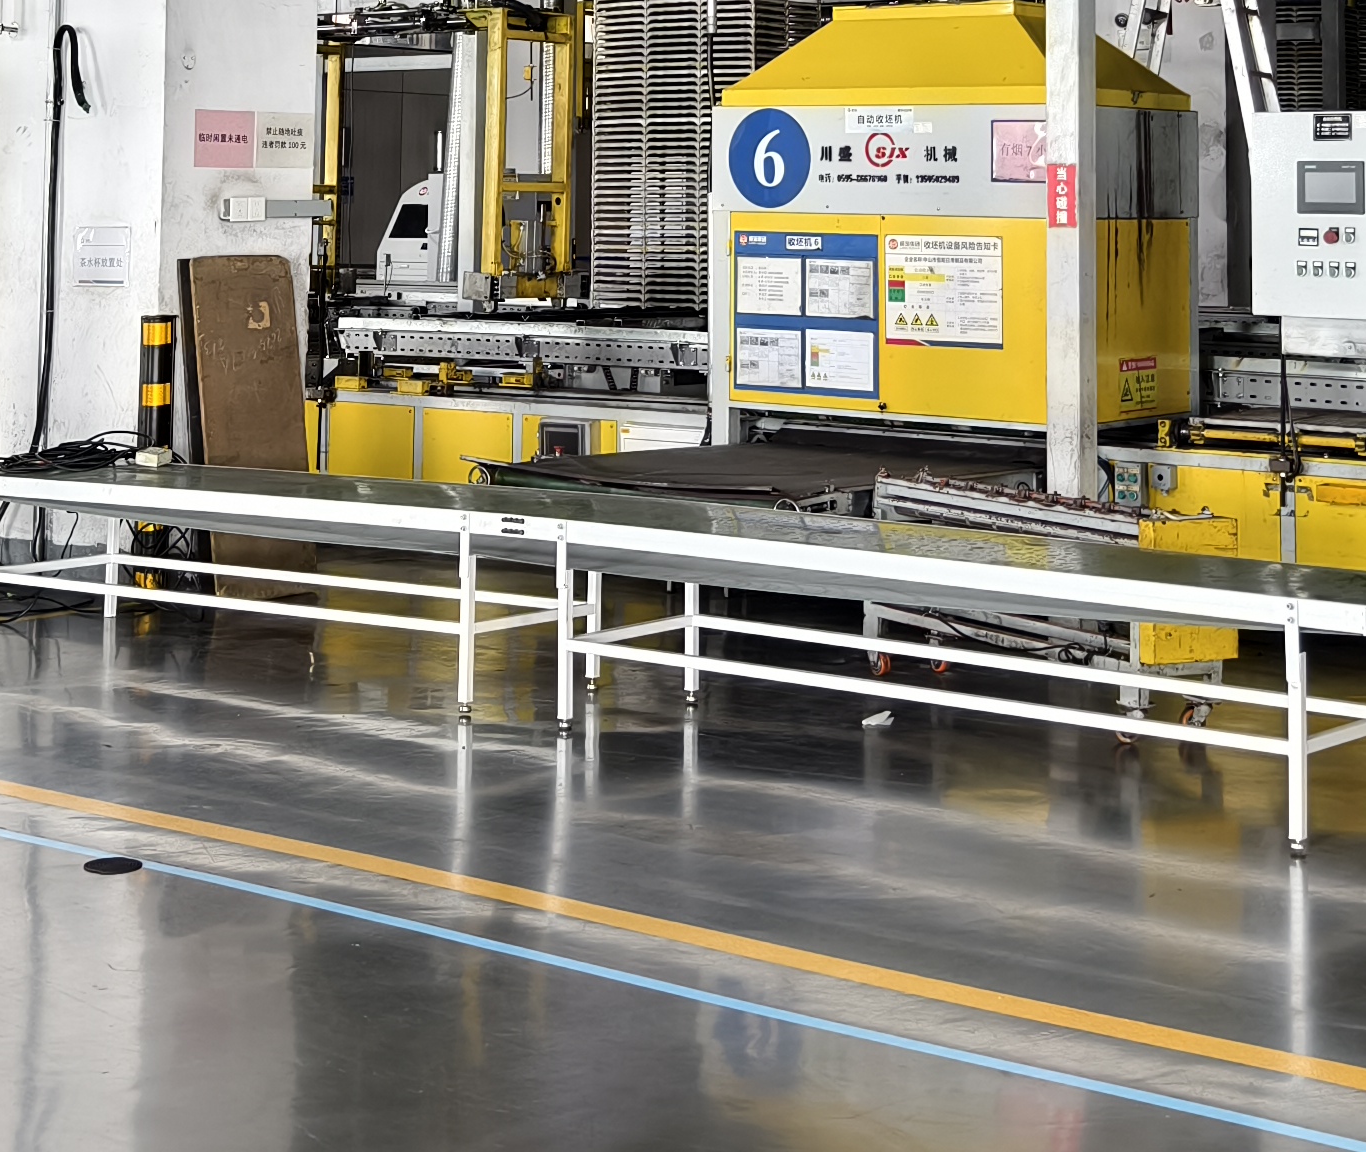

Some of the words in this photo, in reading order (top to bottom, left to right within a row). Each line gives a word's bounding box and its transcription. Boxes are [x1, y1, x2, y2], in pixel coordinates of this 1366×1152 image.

[857, 114, 903, 124] 自动收坯机
[198, 132, 248, 144] 临时闲置未通电
[753, 129, 785, 188] 6
[924, 145, 958, 162] 机械
[787, 237, 812, 247] 收坯机
